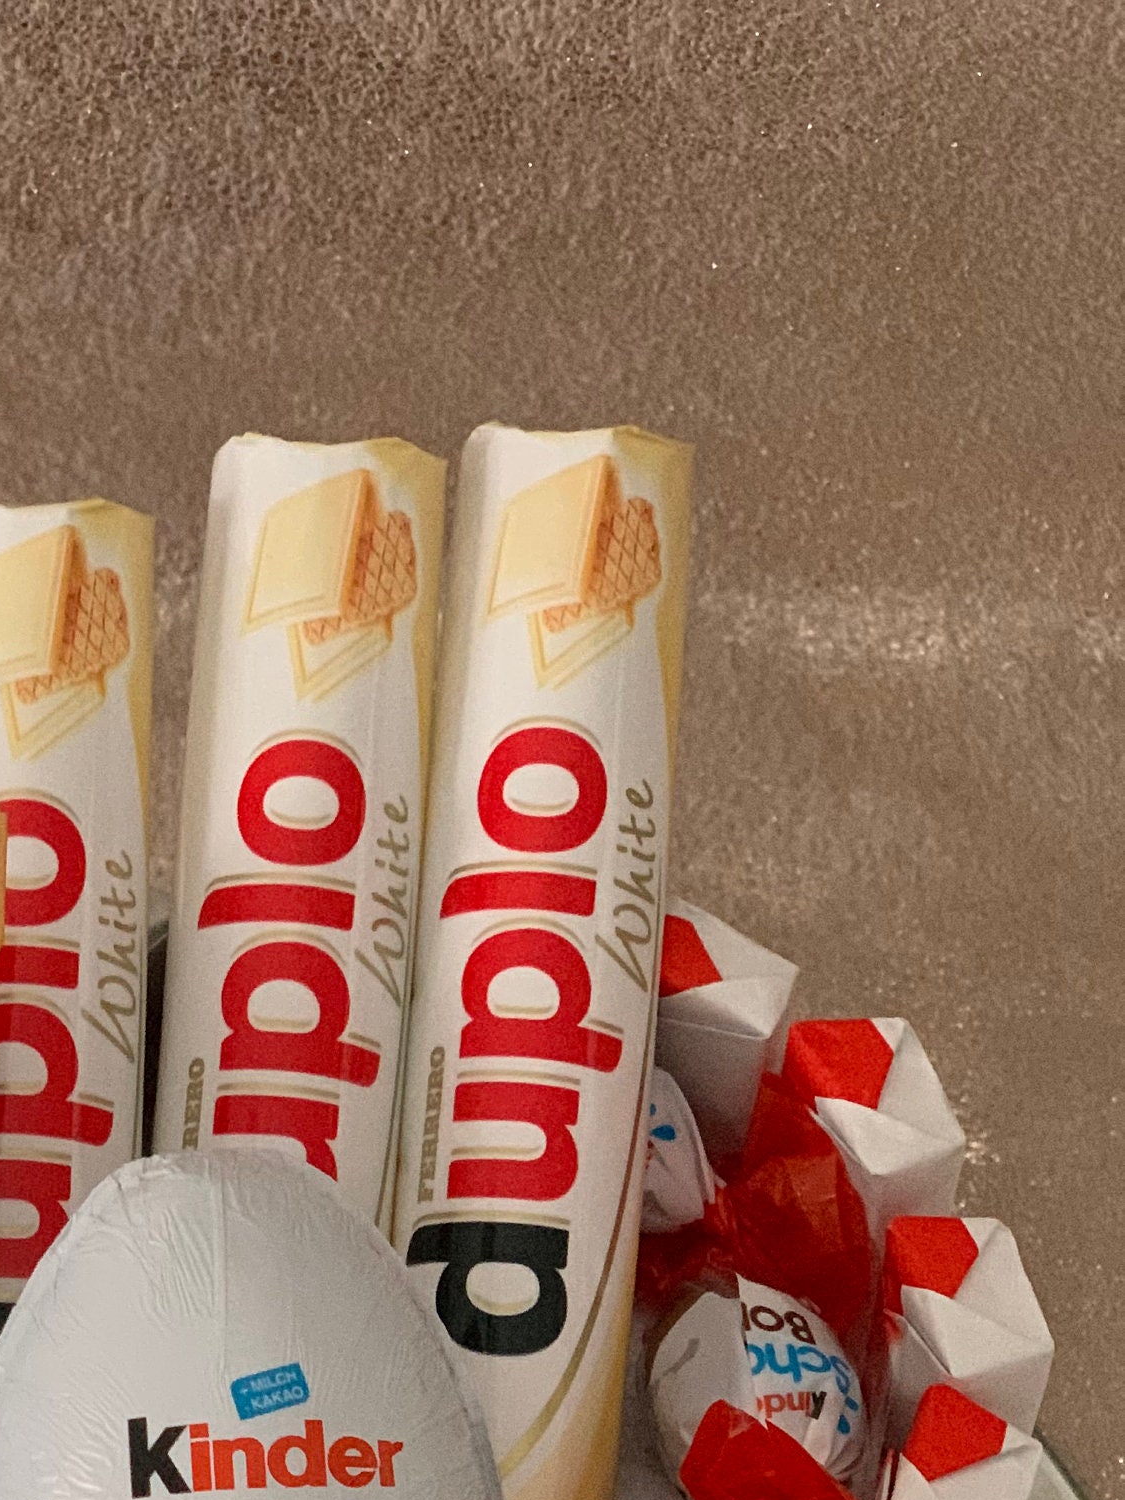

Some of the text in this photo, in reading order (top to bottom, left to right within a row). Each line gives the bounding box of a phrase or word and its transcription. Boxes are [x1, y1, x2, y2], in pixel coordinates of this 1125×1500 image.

[81, 848, 134, 1064] White
[198, 738, 380, 1182] plo
[355, 794, 410, 1007] White
[595, 778, 656, 993] White
[182, 1057, 205, 1151] RERO
[407, 726, 623, 1357] duplo
[417, 1046, 446, 1203] FERRERO
[249, 1370, 299, 1392] MILCH
[250, 1386, 304, 1410] KAKAO
[741, 1302, 817, 1345] Bo
[745, 1343, 852, 1396] Scho
